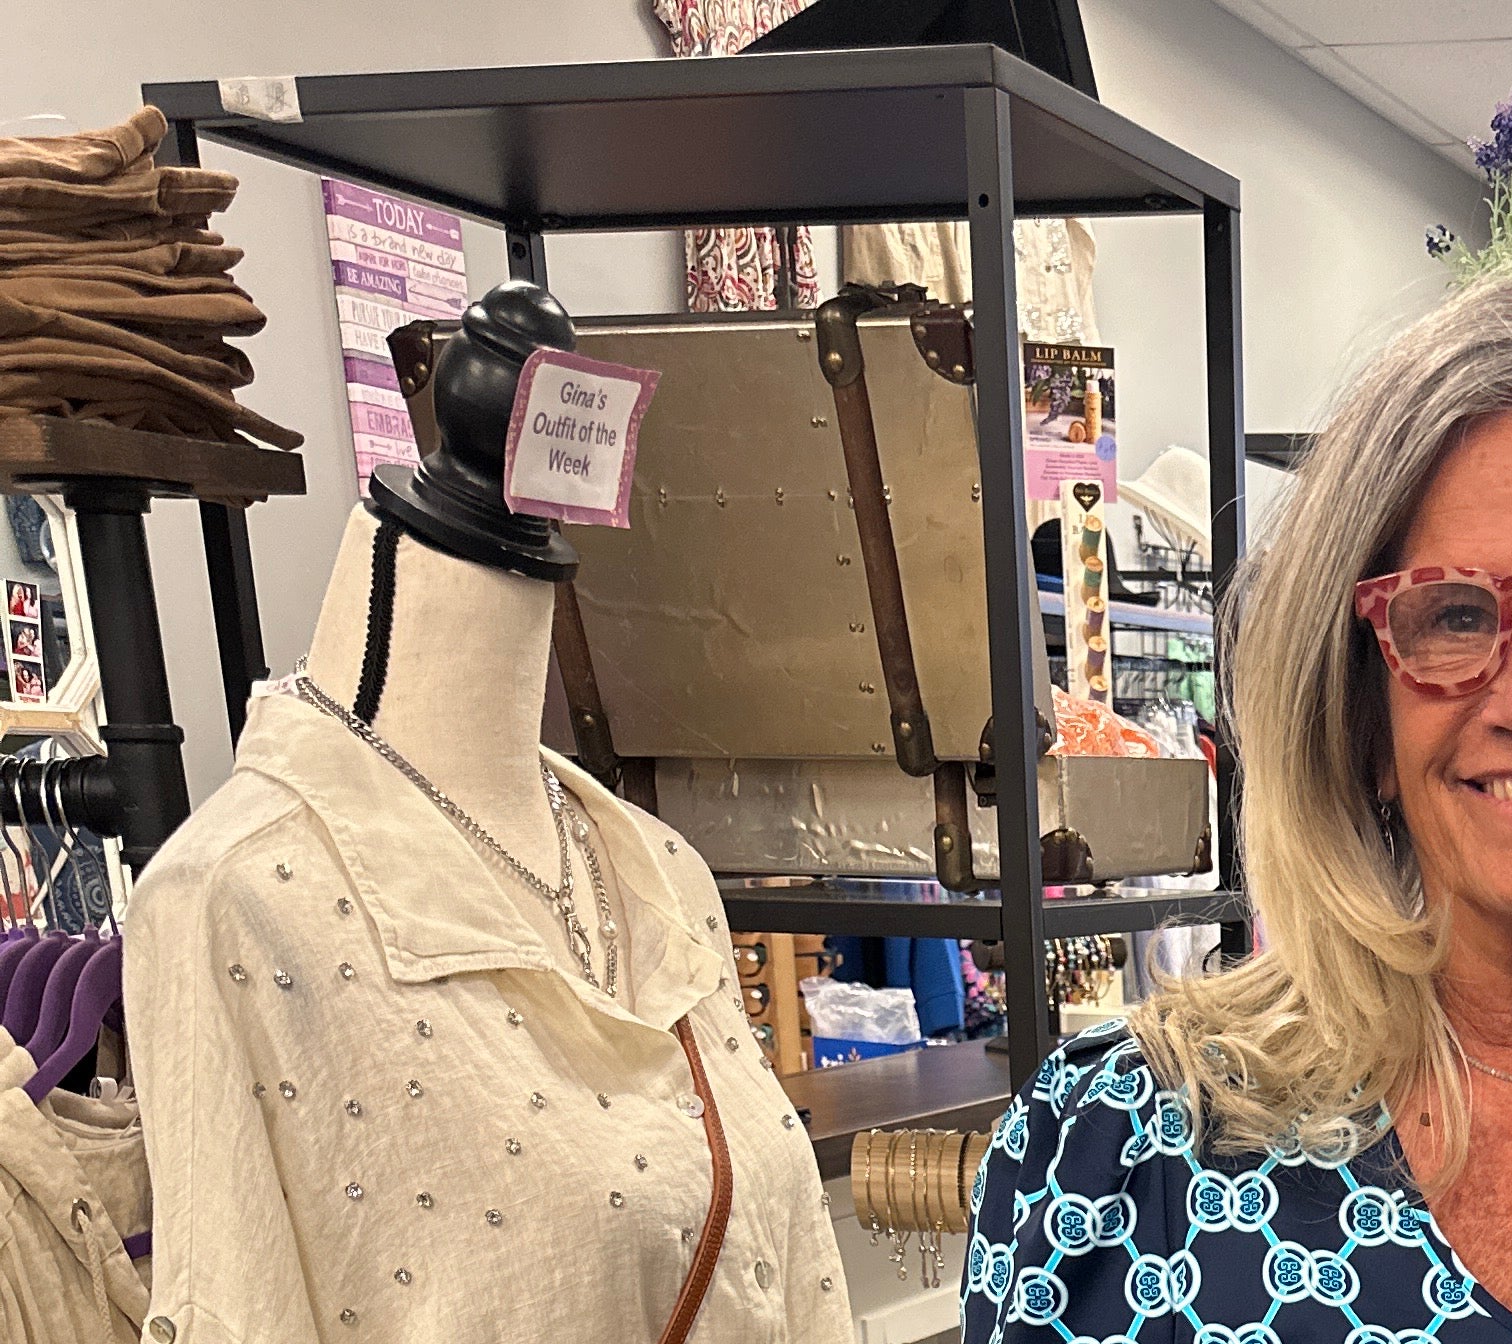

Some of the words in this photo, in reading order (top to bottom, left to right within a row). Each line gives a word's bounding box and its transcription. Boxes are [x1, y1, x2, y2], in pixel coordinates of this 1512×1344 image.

[372, 198, 424, 236] TODAY
[347, 223, 357, 239] is
[360, 228, 369, 242] a
[371, 232, 407, 253] brand
[412, 244, 433, 261] new
[437, 247, 457, 269] day
[360, 271, 402, 295] AMAZING
[1035, 347, 1058, 360] LIP
[1062, 348, 1102, 362] BALM
[560, 381, 608, 410] Gina's
[533, 412, 577, 441] Outfit
[578, 420, 595, 444] of
[595, 422, 617, 447] the
[549, 448, 592, 477] Week
